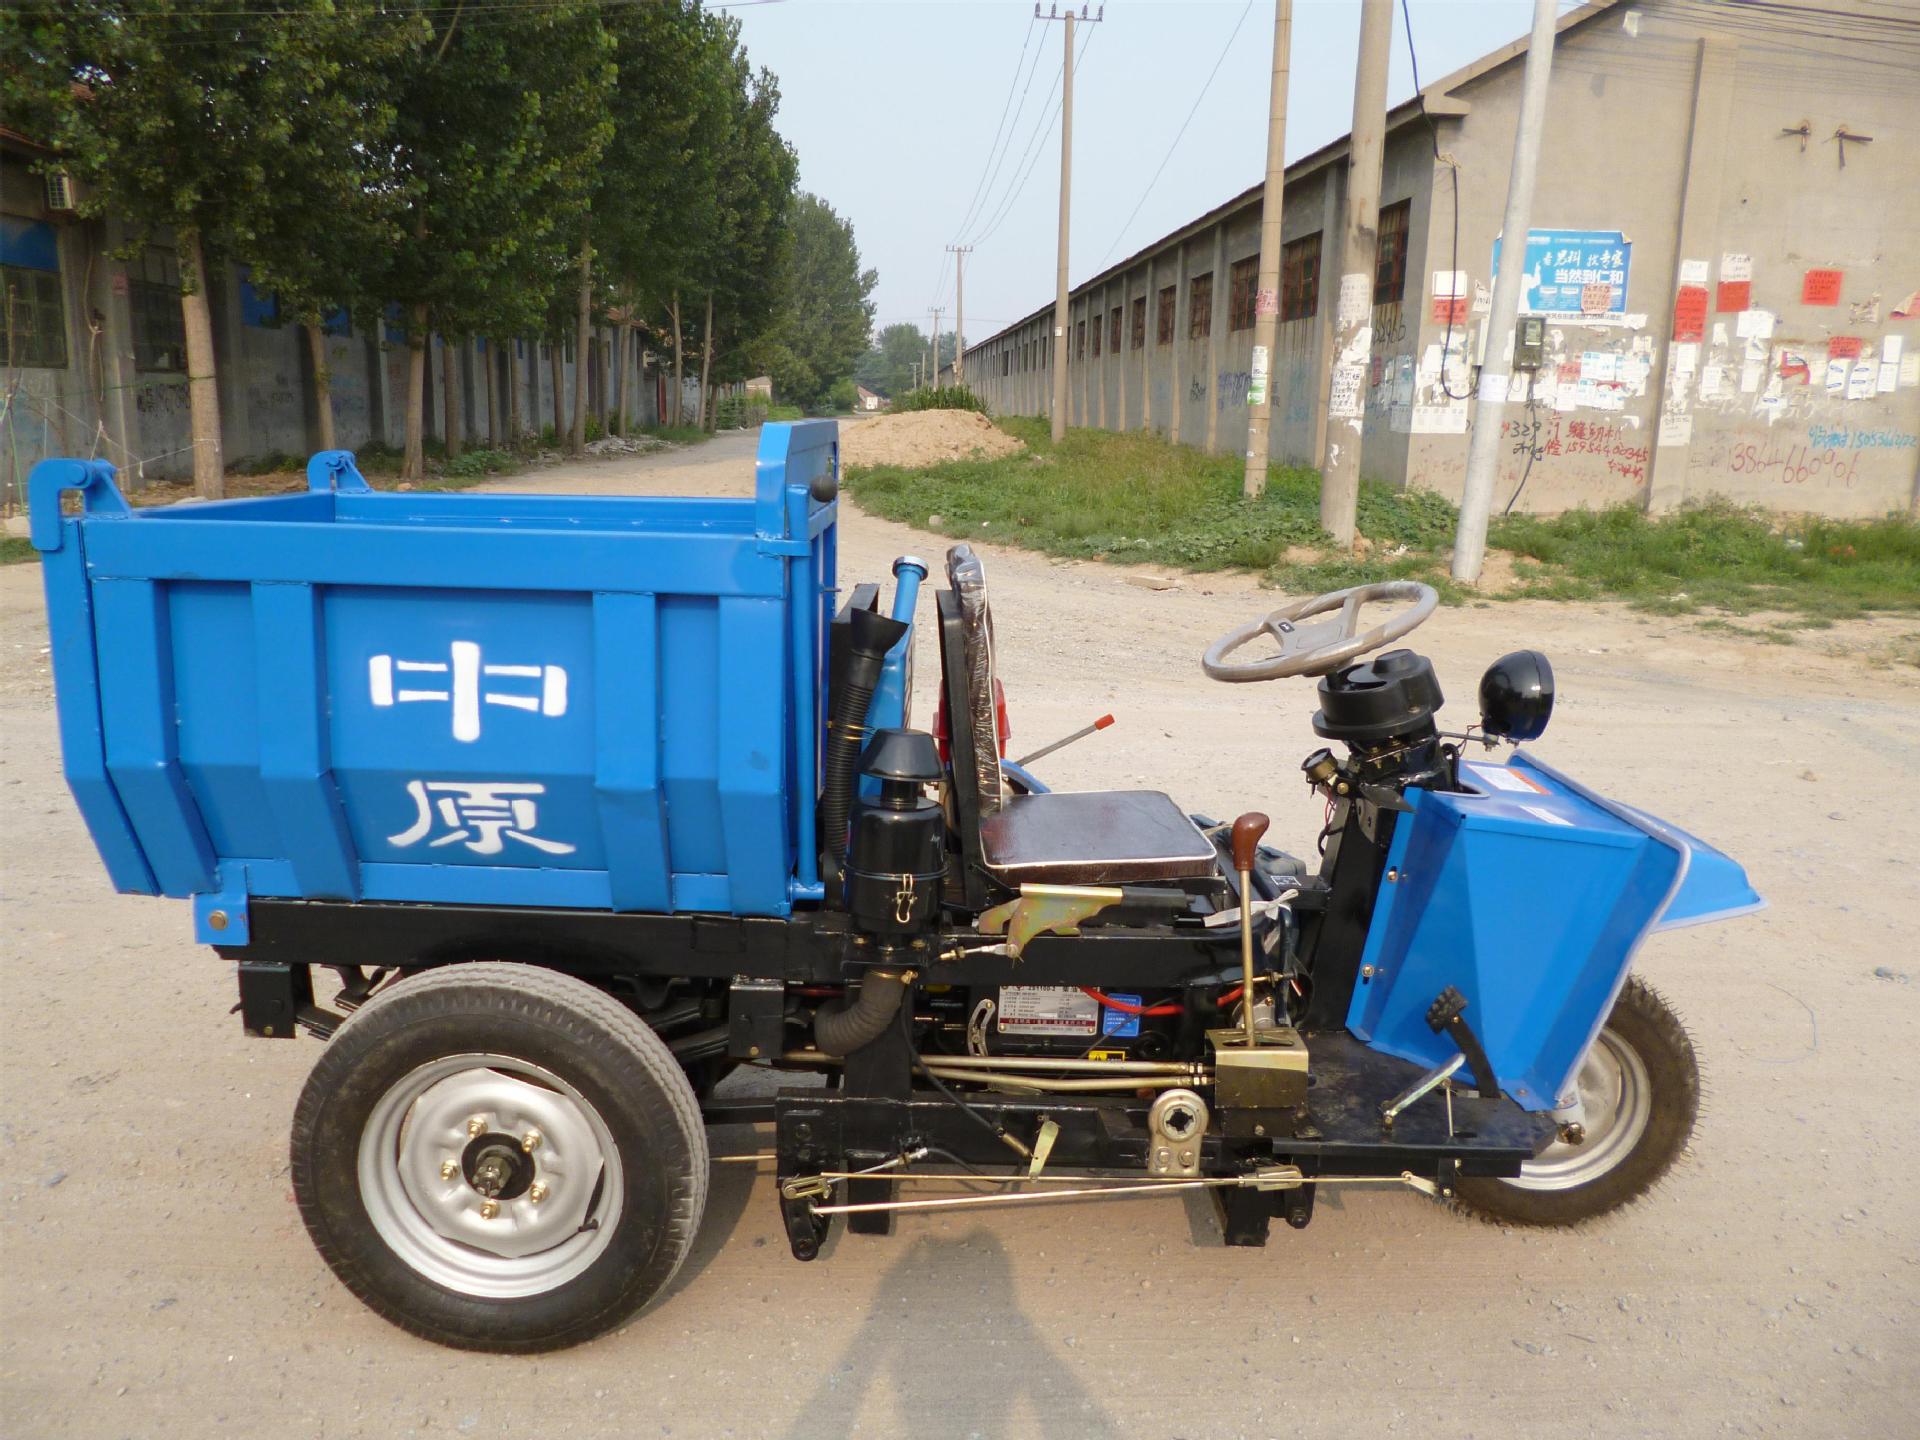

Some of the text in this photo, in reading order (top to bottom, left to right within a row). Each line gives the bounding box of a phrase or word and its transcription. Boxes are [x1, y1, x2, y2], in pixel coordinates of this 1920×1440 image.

[1554, 268, 1624, 285] 当然到仁和
